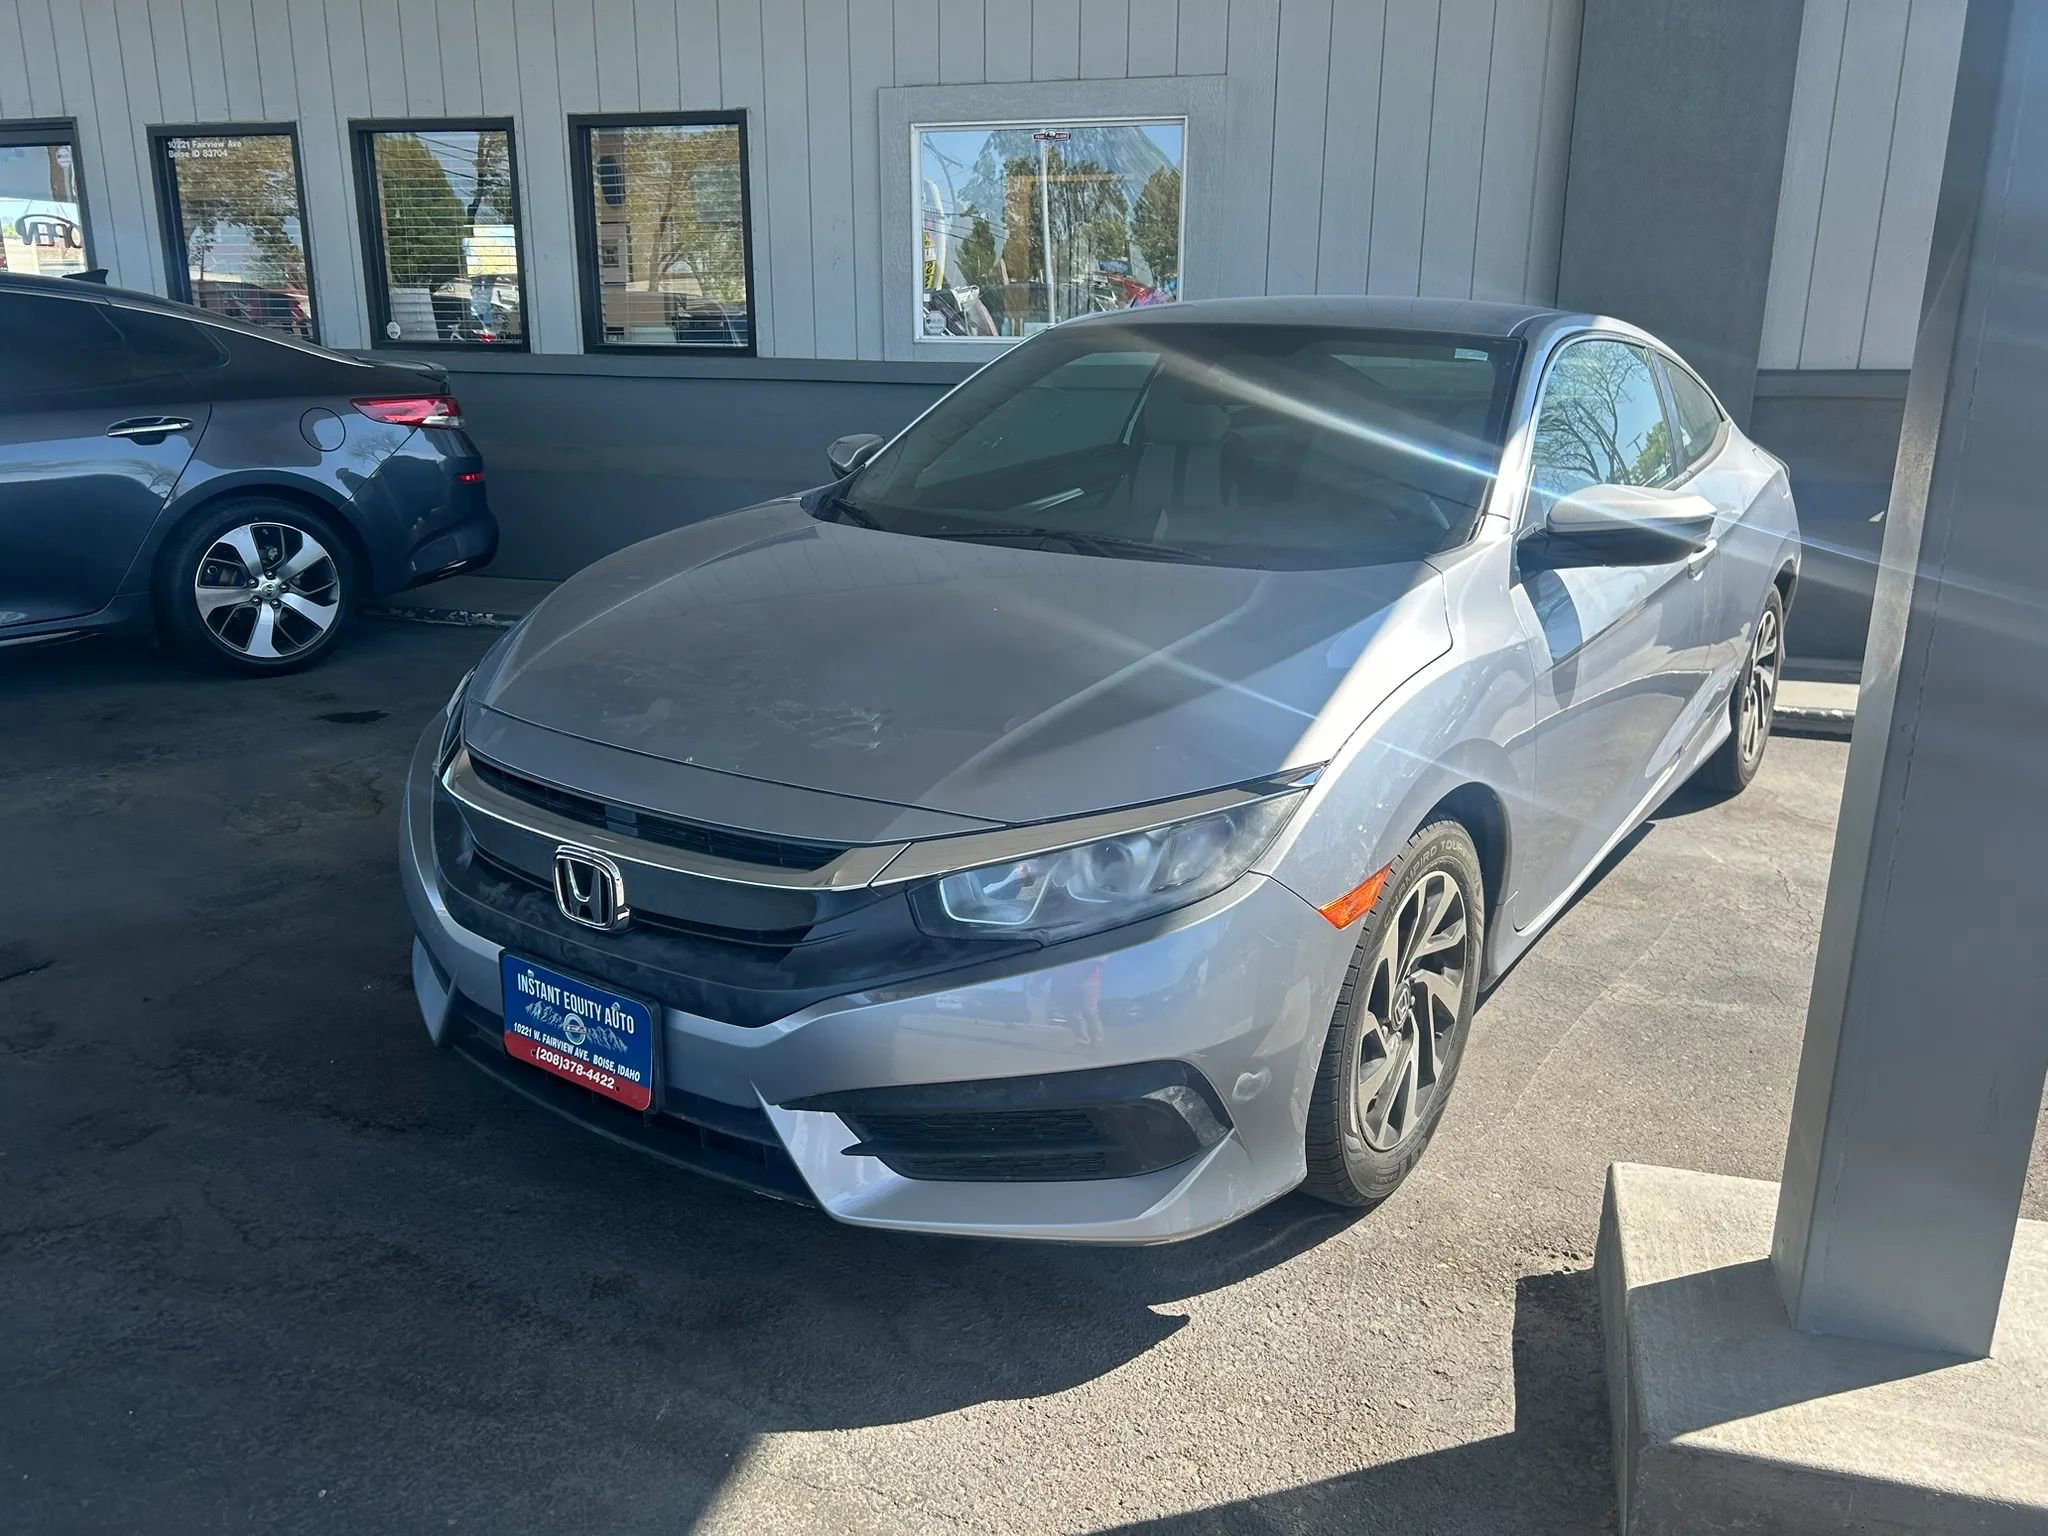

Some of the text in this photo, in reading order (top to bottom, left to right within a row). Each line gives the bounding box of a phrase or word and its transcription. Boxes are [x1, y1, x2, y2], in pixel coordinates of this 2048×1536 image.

[168, 140, 190, 149] 10221
[192, 149, 200, 158] ID
[202, 149, 228, 158] 83704
[517, 972, 635, 1035] INSTANT EQUITY AUTO
[513, 1021, 641, 1083] 10221 W. FAIRVIEW AVE. BOISE, IDAHO
[535, 1046, 615, 1090] (208)378-4422
